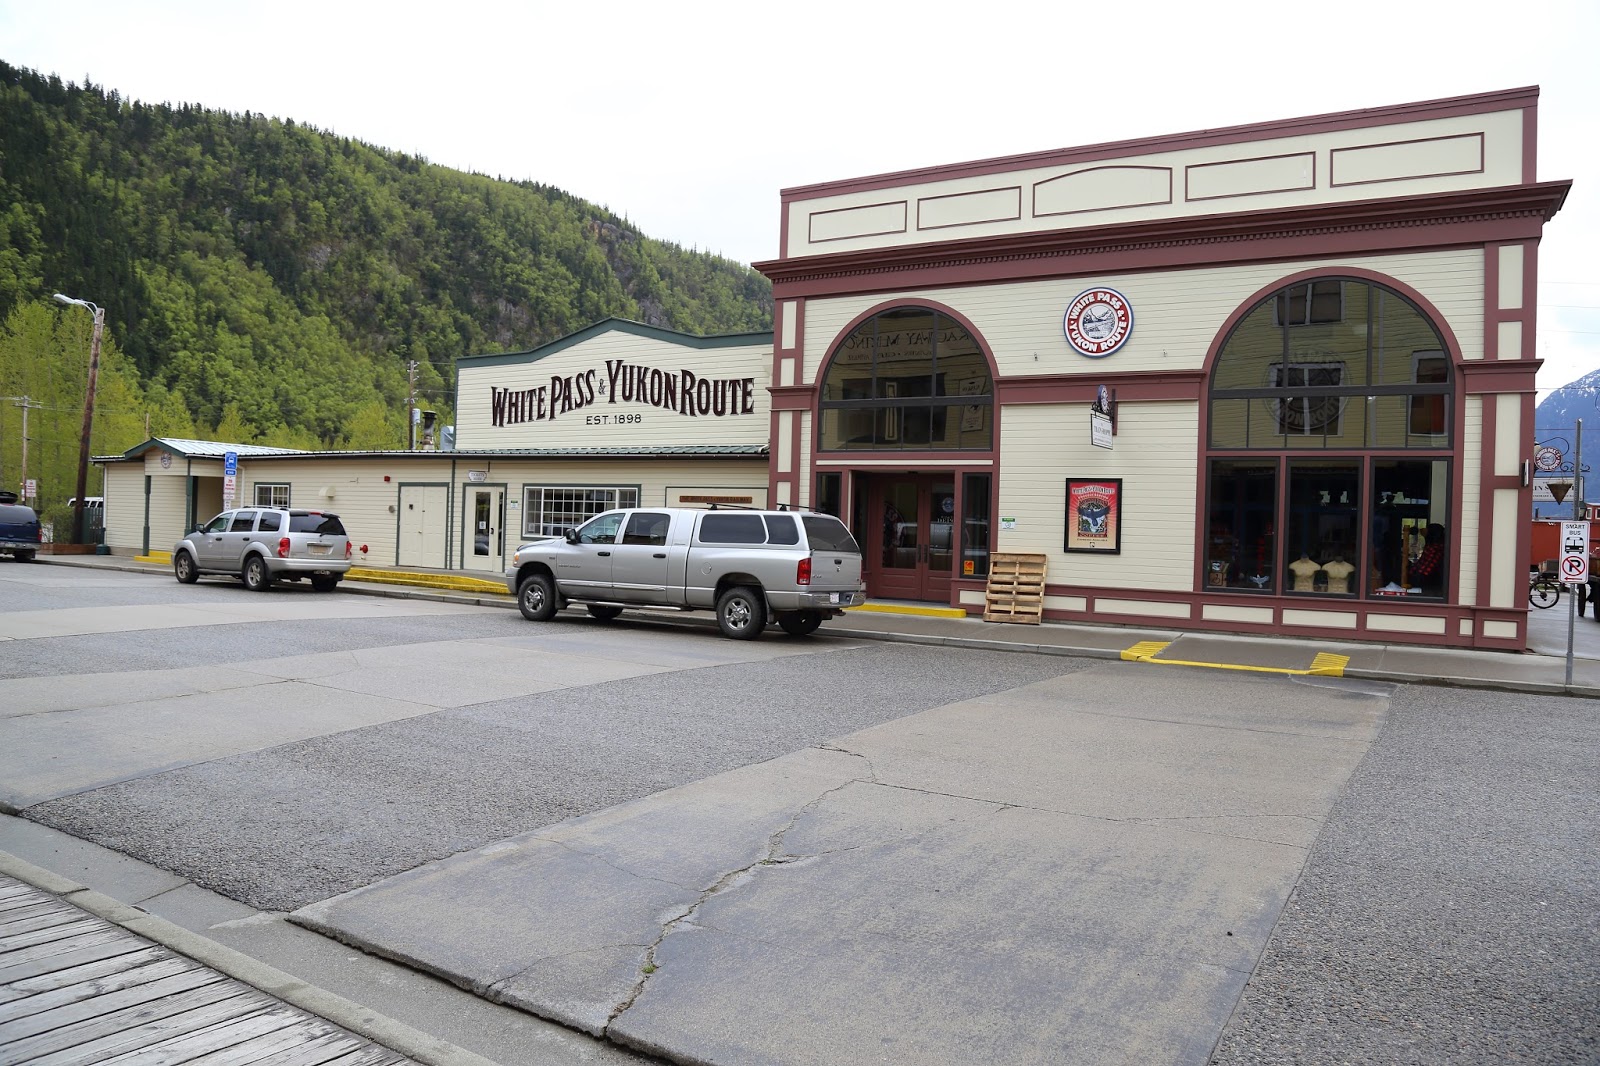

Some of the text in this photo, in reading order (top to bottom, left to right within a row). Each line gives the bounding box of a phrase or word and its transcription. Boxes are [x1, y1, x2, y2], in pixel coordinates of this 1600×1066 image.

[1069, 293, 1095, 320] WHITE
[1097, 292, 1122, 310] PASS
[1069, 321, 1127, 352] YUKON ROUTE
[491, 359, 755, 427] WHITE PASS & YUKON ROUTE
[586, 414, 642, 425] EST. 1898
